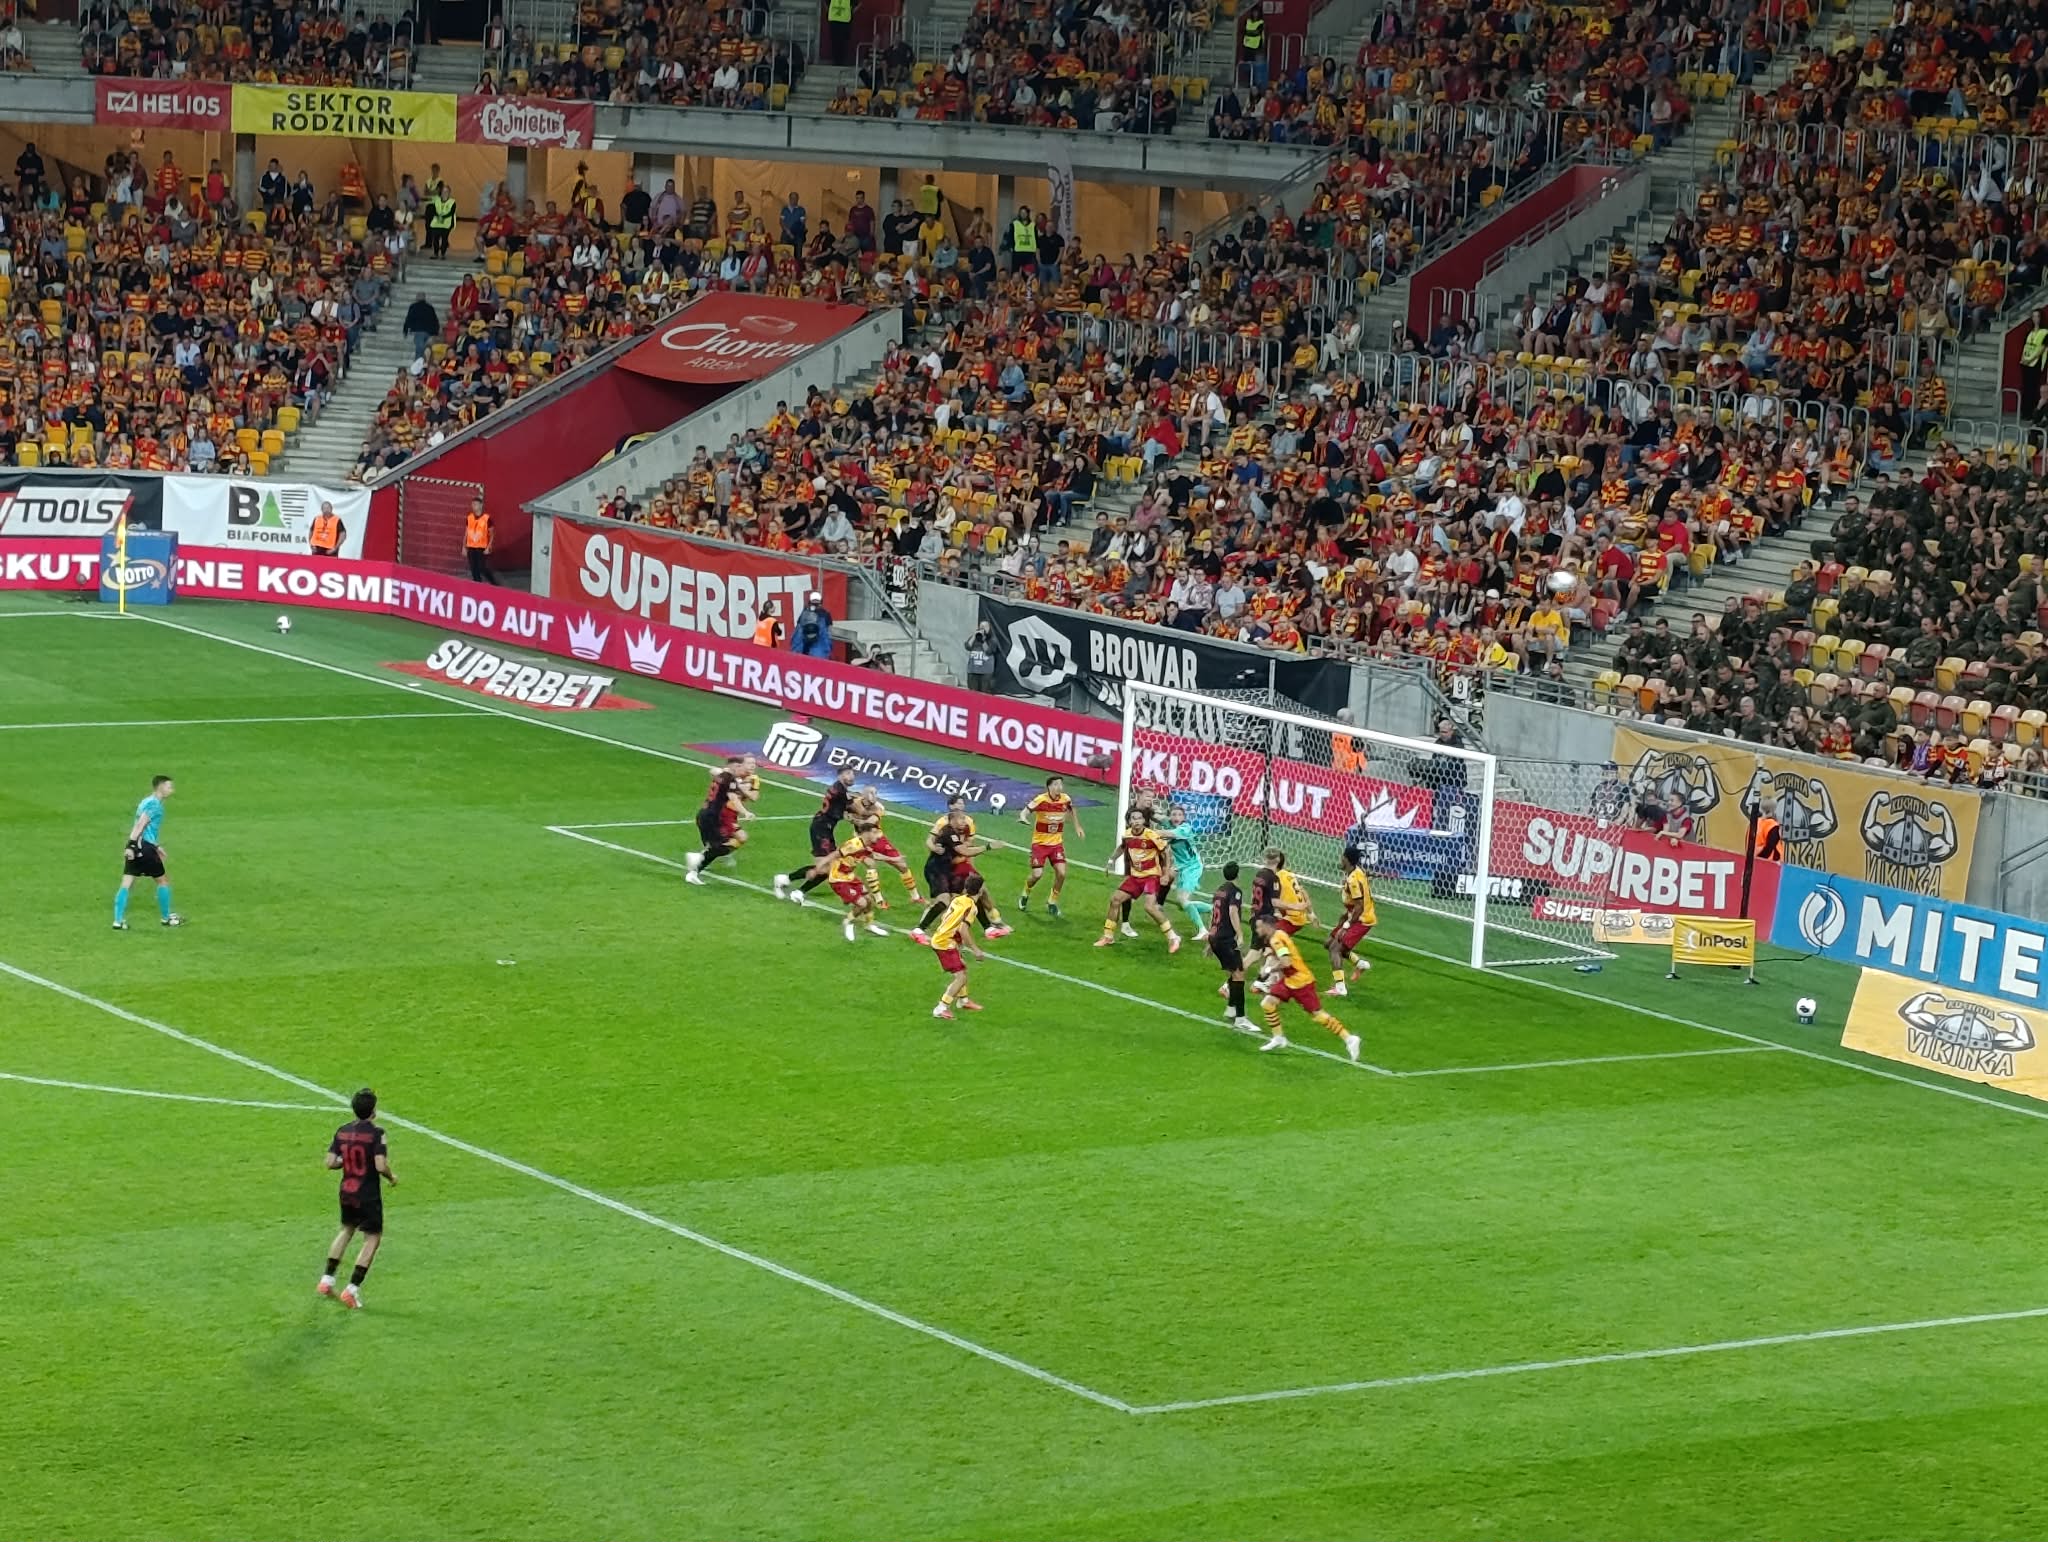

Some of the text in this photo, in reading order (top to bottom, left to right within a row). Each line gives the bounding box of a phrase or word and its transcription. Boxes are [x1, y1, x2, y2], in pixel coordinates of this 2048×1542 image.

[143, 95, 221, 117] HELIOS
[271, 111, 415, 137] RODZINNY
[287, 93, 392, 114] SEKTOR
[661, 322, 815, 360] Chorten
[15, 497, 125, 524] TOOLS
[227, 529, 292, 543] BIAFORM
[258, 565, 454, 620] KOSMETYKI
[460, 595, 496, 629] DO
[501, 606, 555, 641] AUT
[579, 533, 813, 641] SUPERBET
[426, 639, 616, 709] SUPERBET
[1089, 629, 1199, 690] BROWAR
[684, 645, 968, 738] ULTRASKUTECZNE
[1190, 760, 1242, 798] DO
[1251, 773, 1332, 819] AUT
[827, 747, 901, 780] Bank
[902, 766, 985, 803] Polski
[1699, 932, 1748, 949] InPost
[1856, 895, 2045, 998] MITE
[1907, 1027, 2014, 1077] VIKINGA
[340, 1143, 367, 1177] 10
